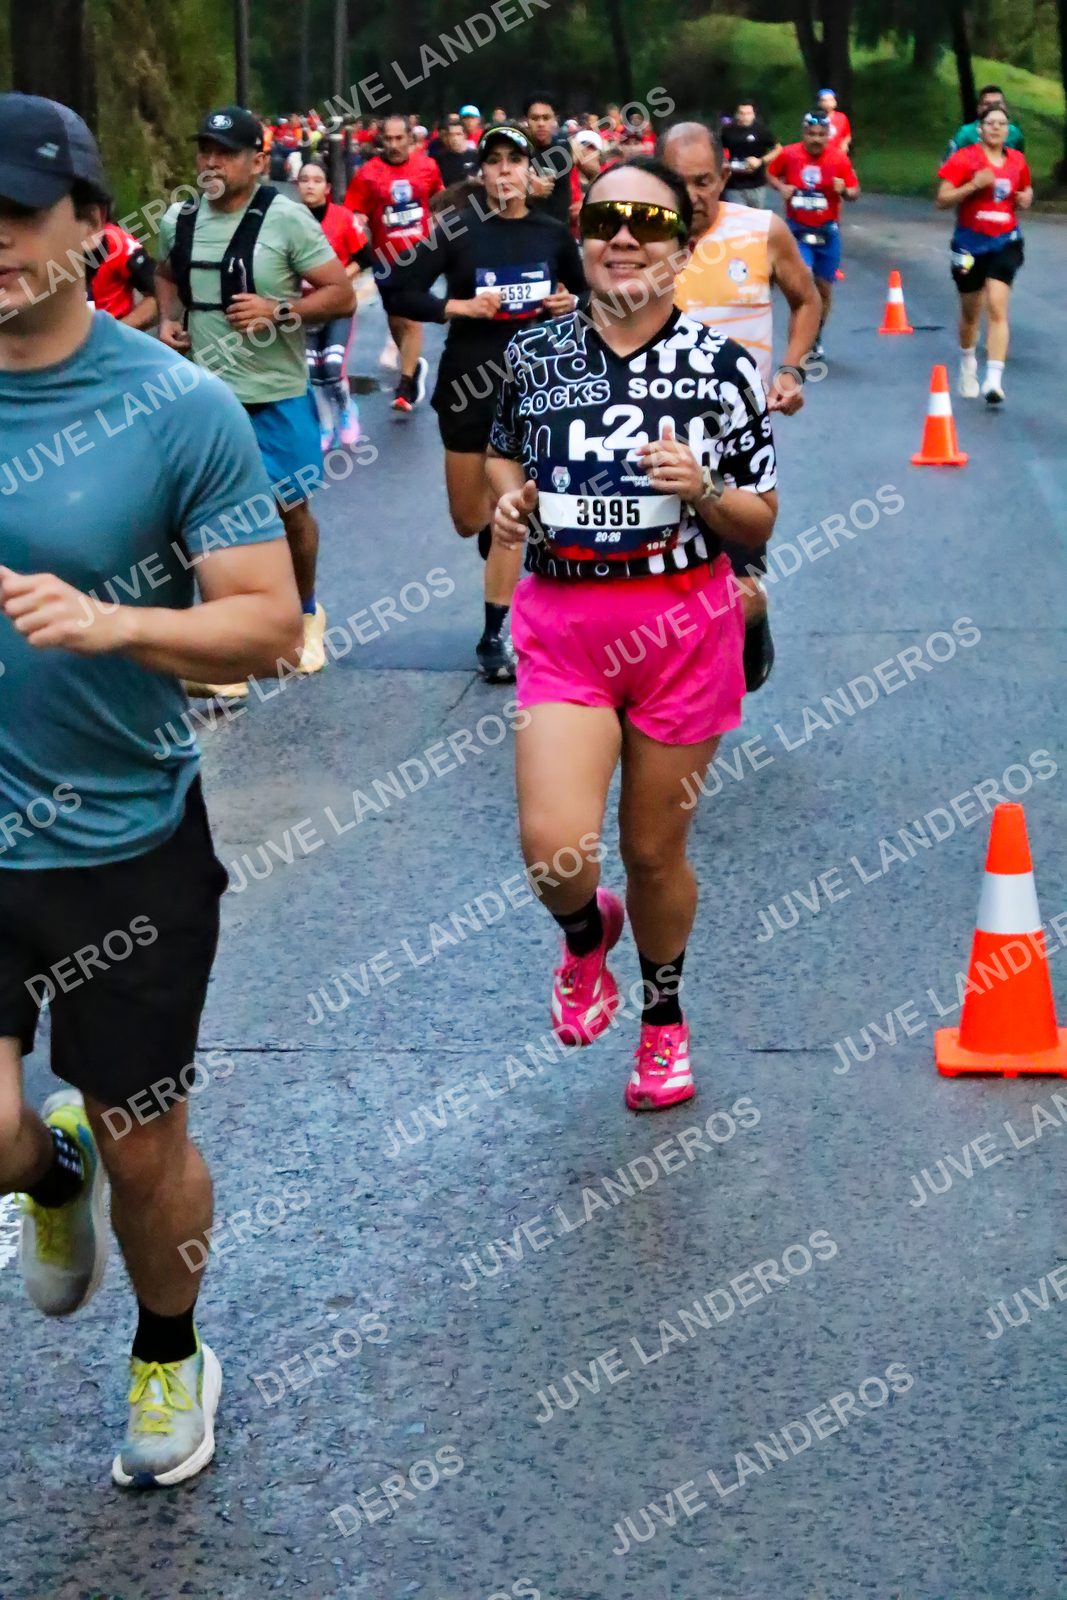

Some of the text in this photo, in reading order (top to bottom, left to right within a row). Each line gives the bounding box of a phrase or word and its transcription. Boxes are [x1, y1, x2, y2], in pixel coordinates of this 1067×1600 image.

[519, 379, 611, 416] SOCKS
[628, 377, 721, 401] SOCK
[577, 498, 640, 526] 3995
